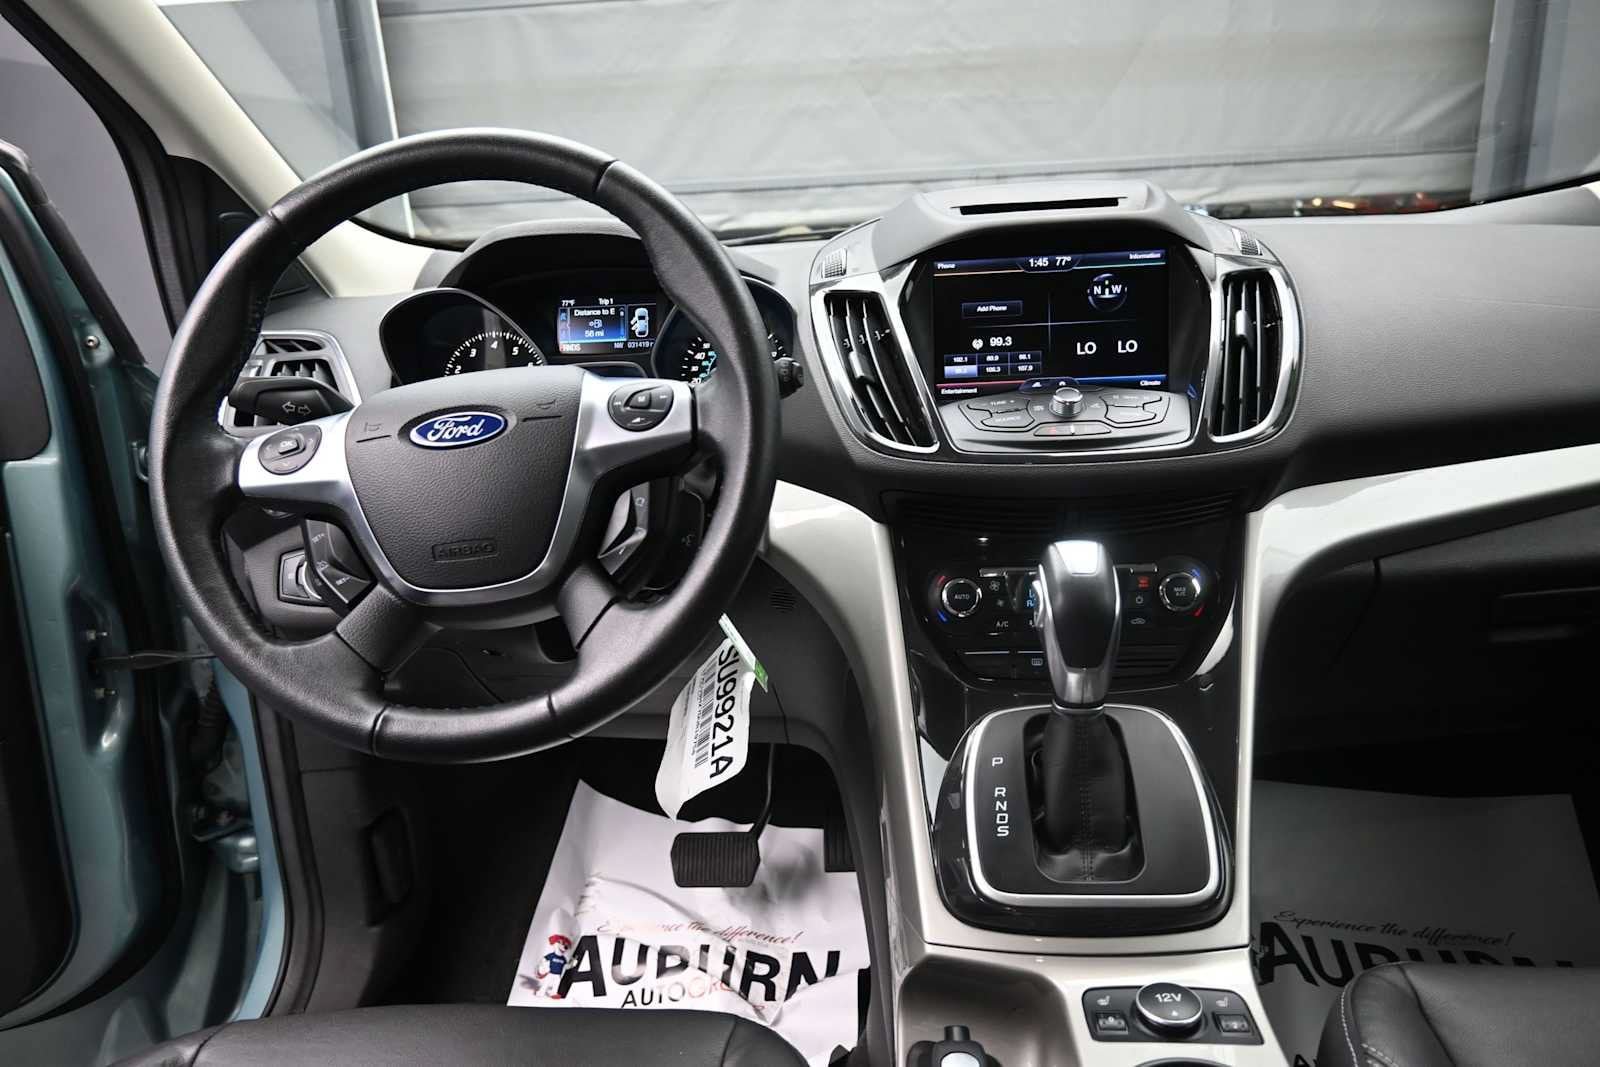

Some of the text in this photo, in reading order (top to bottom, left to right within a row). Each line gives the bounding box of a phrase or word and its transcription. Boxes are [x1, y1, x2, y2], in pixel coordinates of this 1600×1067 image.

[1028, 257, 1049, 267] 1:45
[573, 307, 615, 316] Distance to E
[595, 329, 604, 337] mi
[490, 340, 498, 349] 4
[989, 336, 1013, 347] 99.3
[1117, 339, 1138, 354] LO
[469, 348, 477, 357] 3
[511, 347, 519, 356] 5
[1076, 341, 1097, 356] LO
[694, 351, 706, 360] 40
[426, 416, 485, 443] Ford
[280, 440, 298, 448] OK
[709, 644, 740, 779] SU9921A
[992, 757, 1004, 767] P
[994, 787, 1006, 797] R
[995, 801, 1007, 811] N
[996, 813, 1008, 824] D
[996, 825, 1010, 836] S
[1273, 910, 1516, 947] Experience the difference!
[1154, 993, 1182, 1003] 12V
